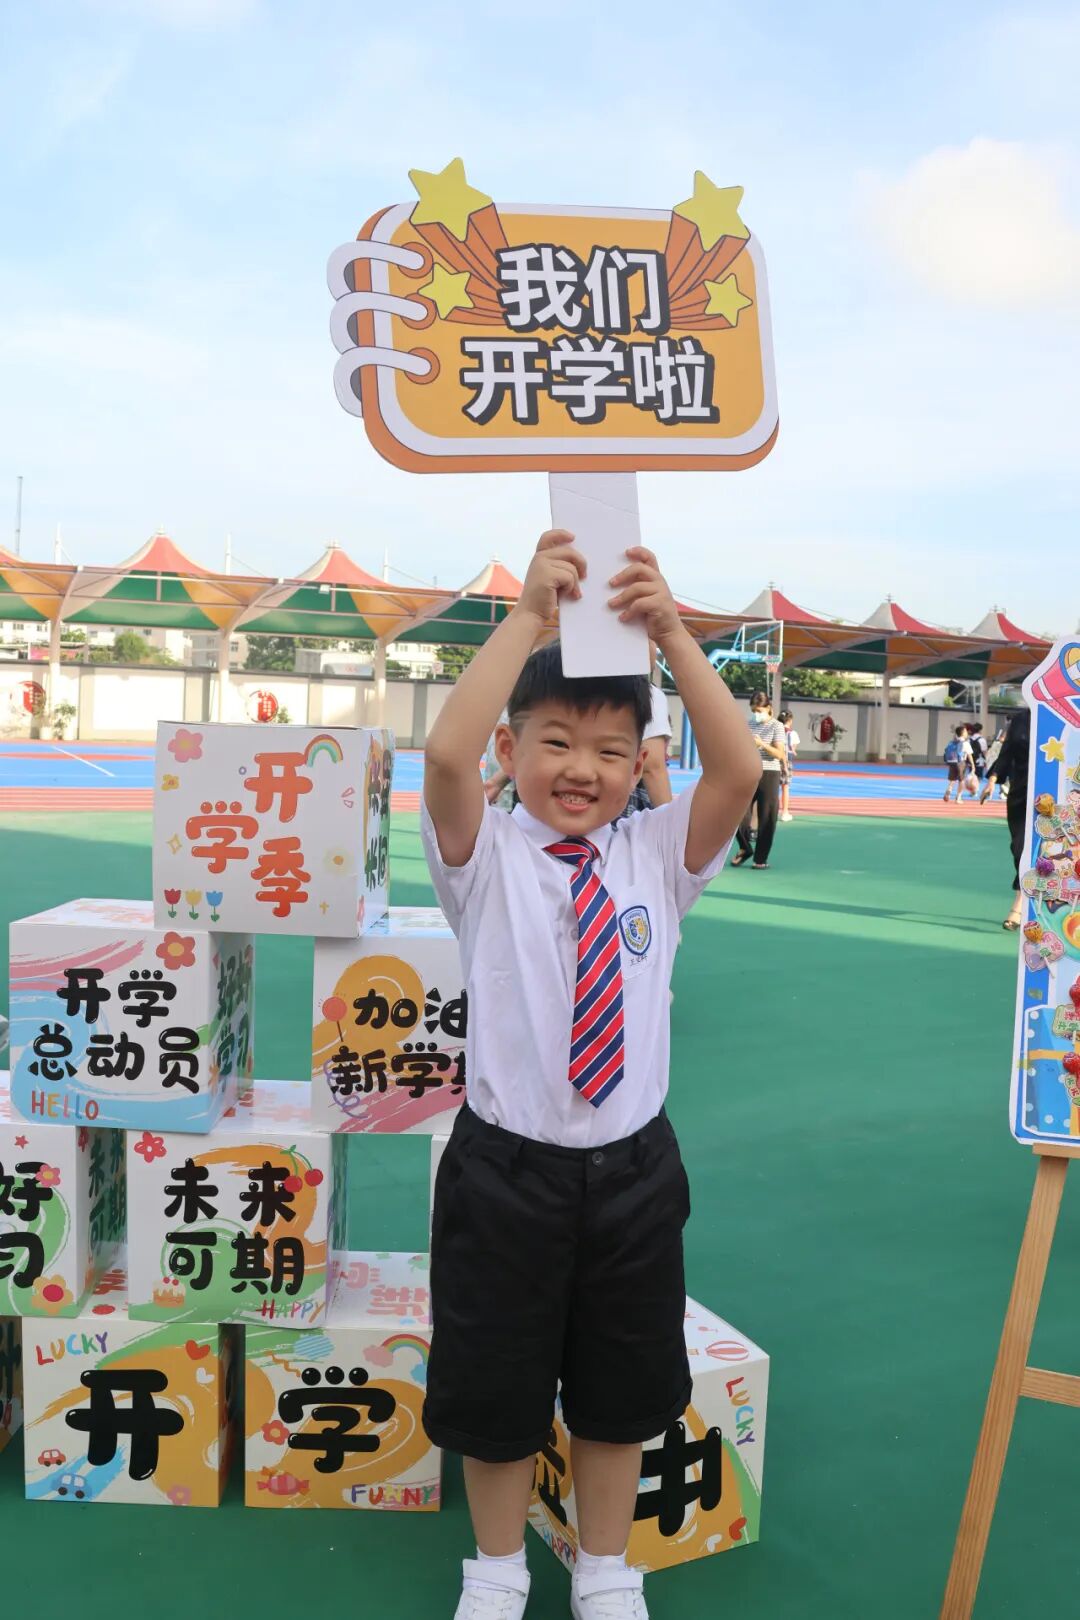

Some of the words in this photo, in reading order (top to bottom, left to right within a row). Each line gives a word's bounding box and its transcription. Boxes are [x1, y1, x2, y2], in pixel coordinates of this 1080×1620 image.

[498, 245, 667, 333] 我们
[462, 336, 718, 423] 开学啦
[57, 968, 177, 1027] 开学
[353, 988, 468, 1039] 加油
[28, 1024, 200, 1093] 总动员
[331, 1042, 467, 1100] 新学
[31, 1091, 99, 1120] HELLO
[164, 1158, 297, 1226] 未来
[165, 1231, 305, 1295] 可期
[256, 1299, 325, 1323] HAPPY
[36, 1331, 108, 1366] LUCKY
[65, 1369, 184, 1481] 开
[278, 1366, 396, 1473] 学
[725, 1376, 755, 1446] LUCKY
[351, 1484, 434, 1506] FUNNY
